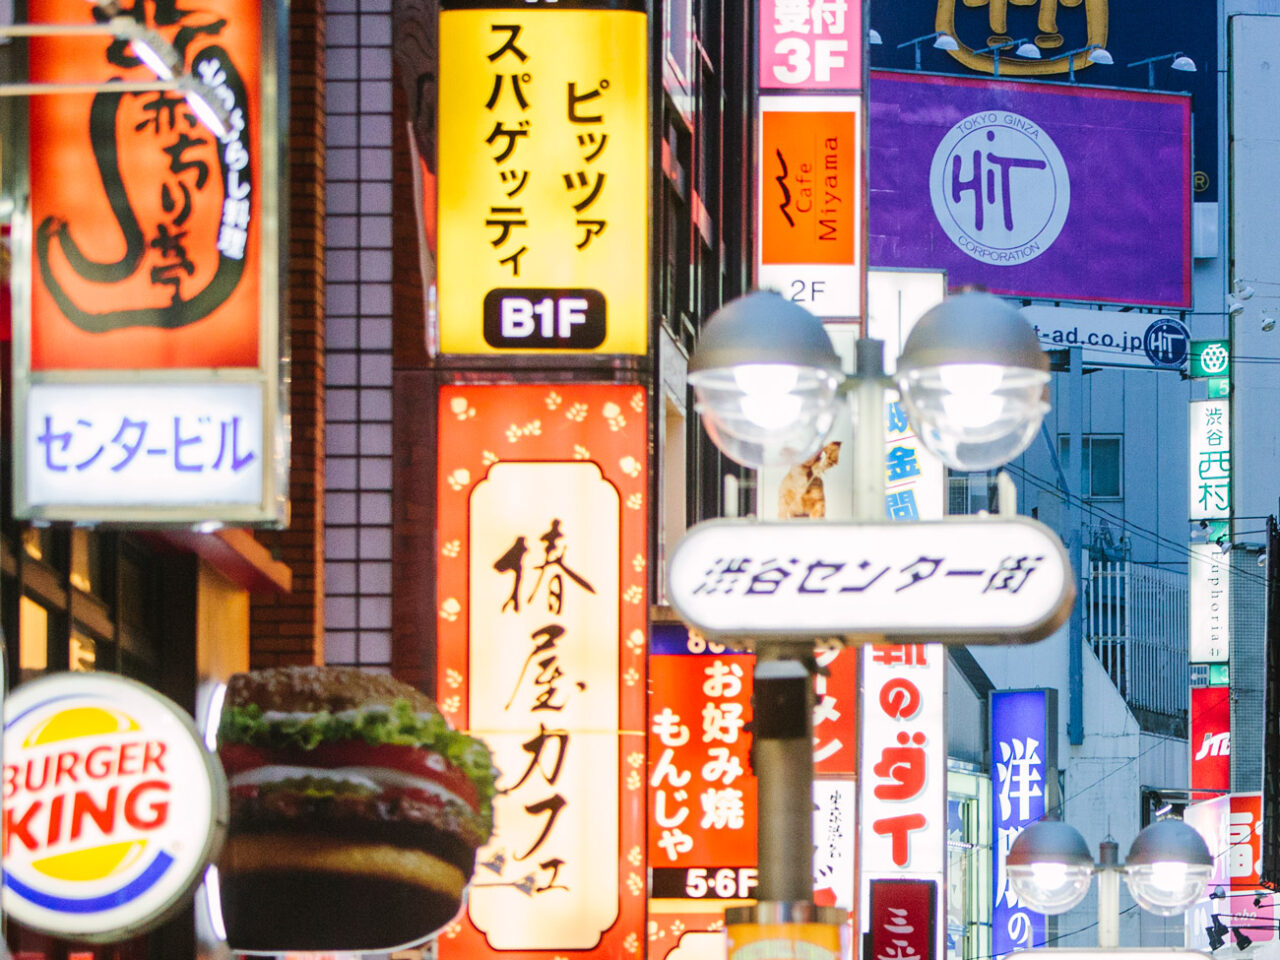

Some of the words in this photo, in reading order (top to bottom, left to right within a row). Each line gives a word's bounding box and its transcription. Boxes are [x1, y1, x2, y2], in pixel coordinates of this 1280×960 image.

[772, 38, 849, 84] 3F
[485, 24, 532, 277] スパゲッティ
[956, 112, 998, 136] TOKYO
[1003, 112, 1042, 141] GINZA
[562, 78, 611, 250] ピッツァ
[796, 162, 813, 214] Cafe
[819, 136, 844, 242] Miyama
[956, 234, 1042, 264] CORPORATION
[500, 297, 589, 339] B1F
[790, 279, 827, 303] 2F
[37, 415, 256, 474] センタービル
[1205, 407, 1224, 446] 渋谷
[1198, 450, 1231, 511] 西村
[692, 554, 1046, 596] 渋谷センター街
[493, 518, 598, 894] 椿屋カフェ
[3, 740, 168, 797] BURGER
[700, 659, 744, 831] お好み焼
[650, 707, 694, 862] もんじゃ
[3, 780, 172, 858] KING
